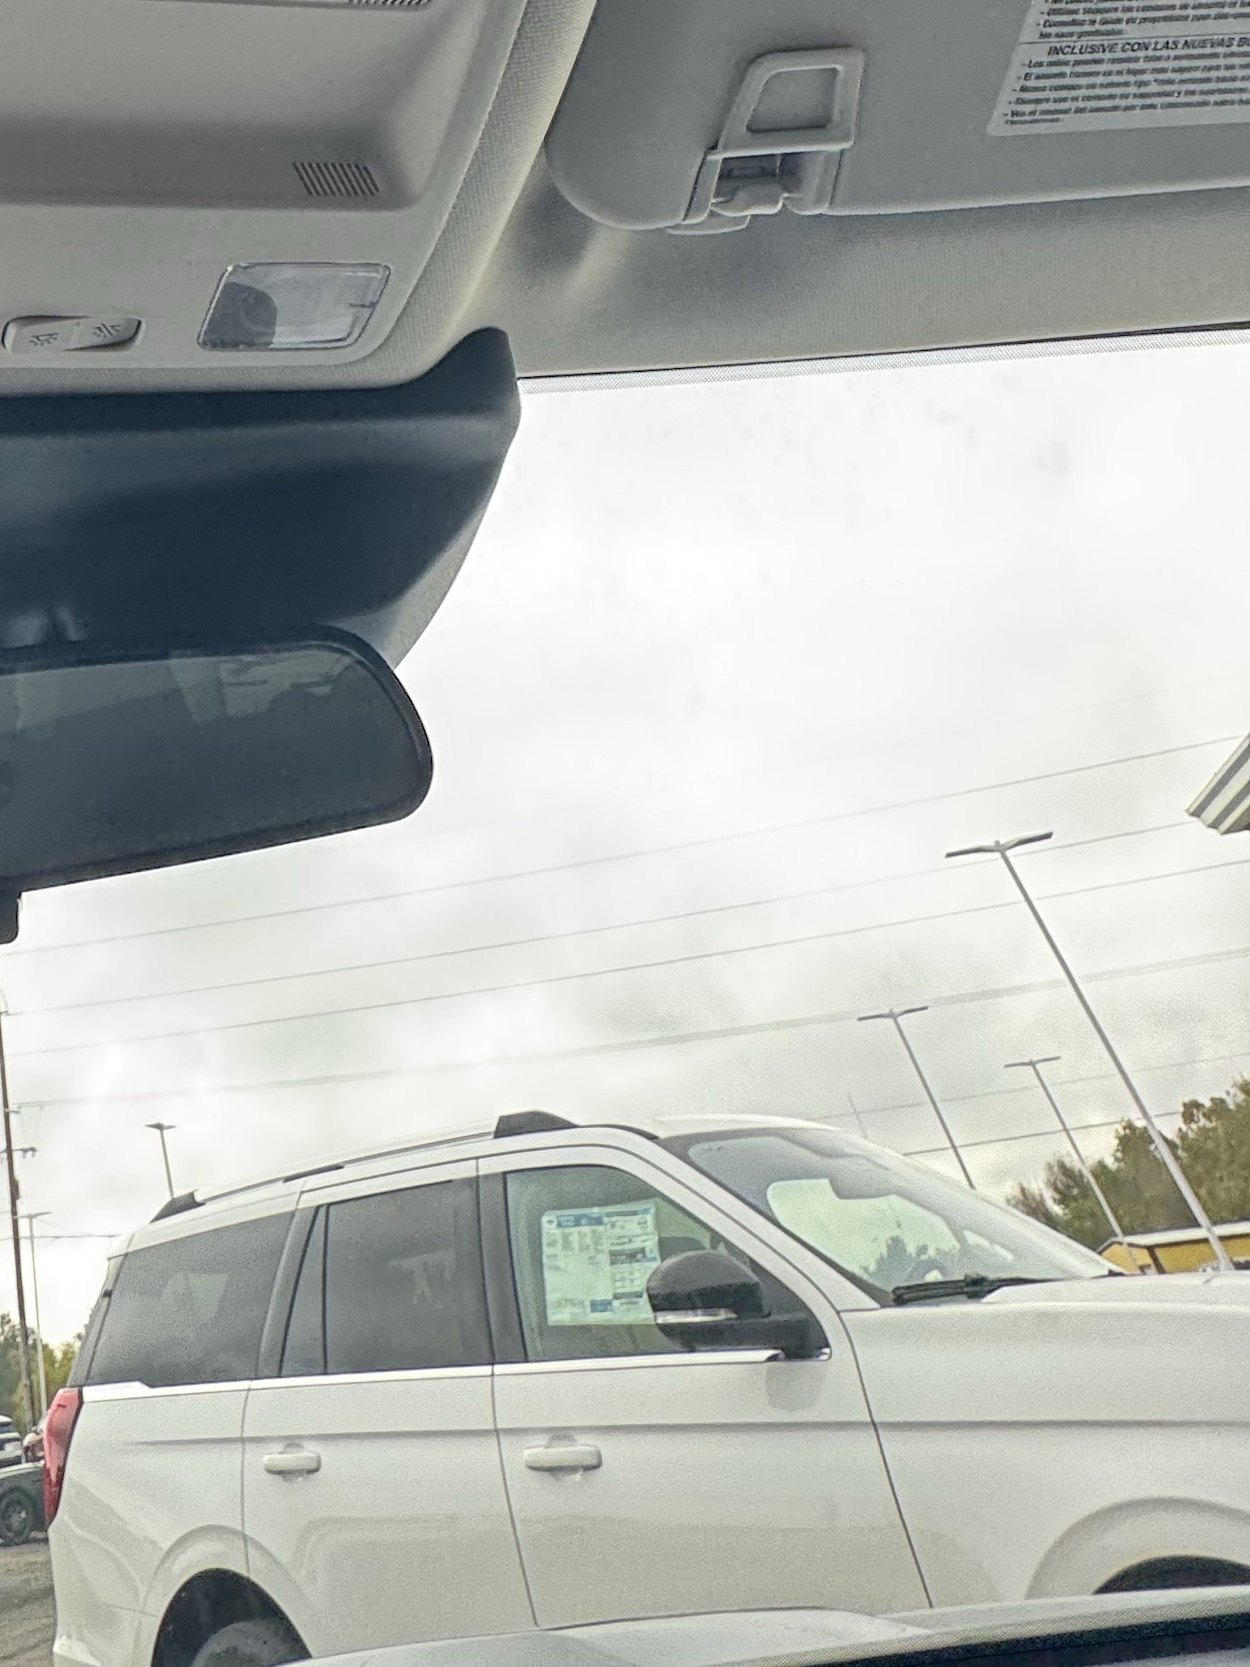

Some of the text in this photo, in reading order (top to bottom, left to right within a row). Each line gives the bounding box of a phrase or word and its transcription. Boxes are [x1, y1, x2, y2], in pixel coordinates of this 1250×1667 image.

[1048, 42, 1119, 56] INCLUSIVE
[1121, 41, 1149, 52] CON
[1152, 40, 1179, 51] LAS
